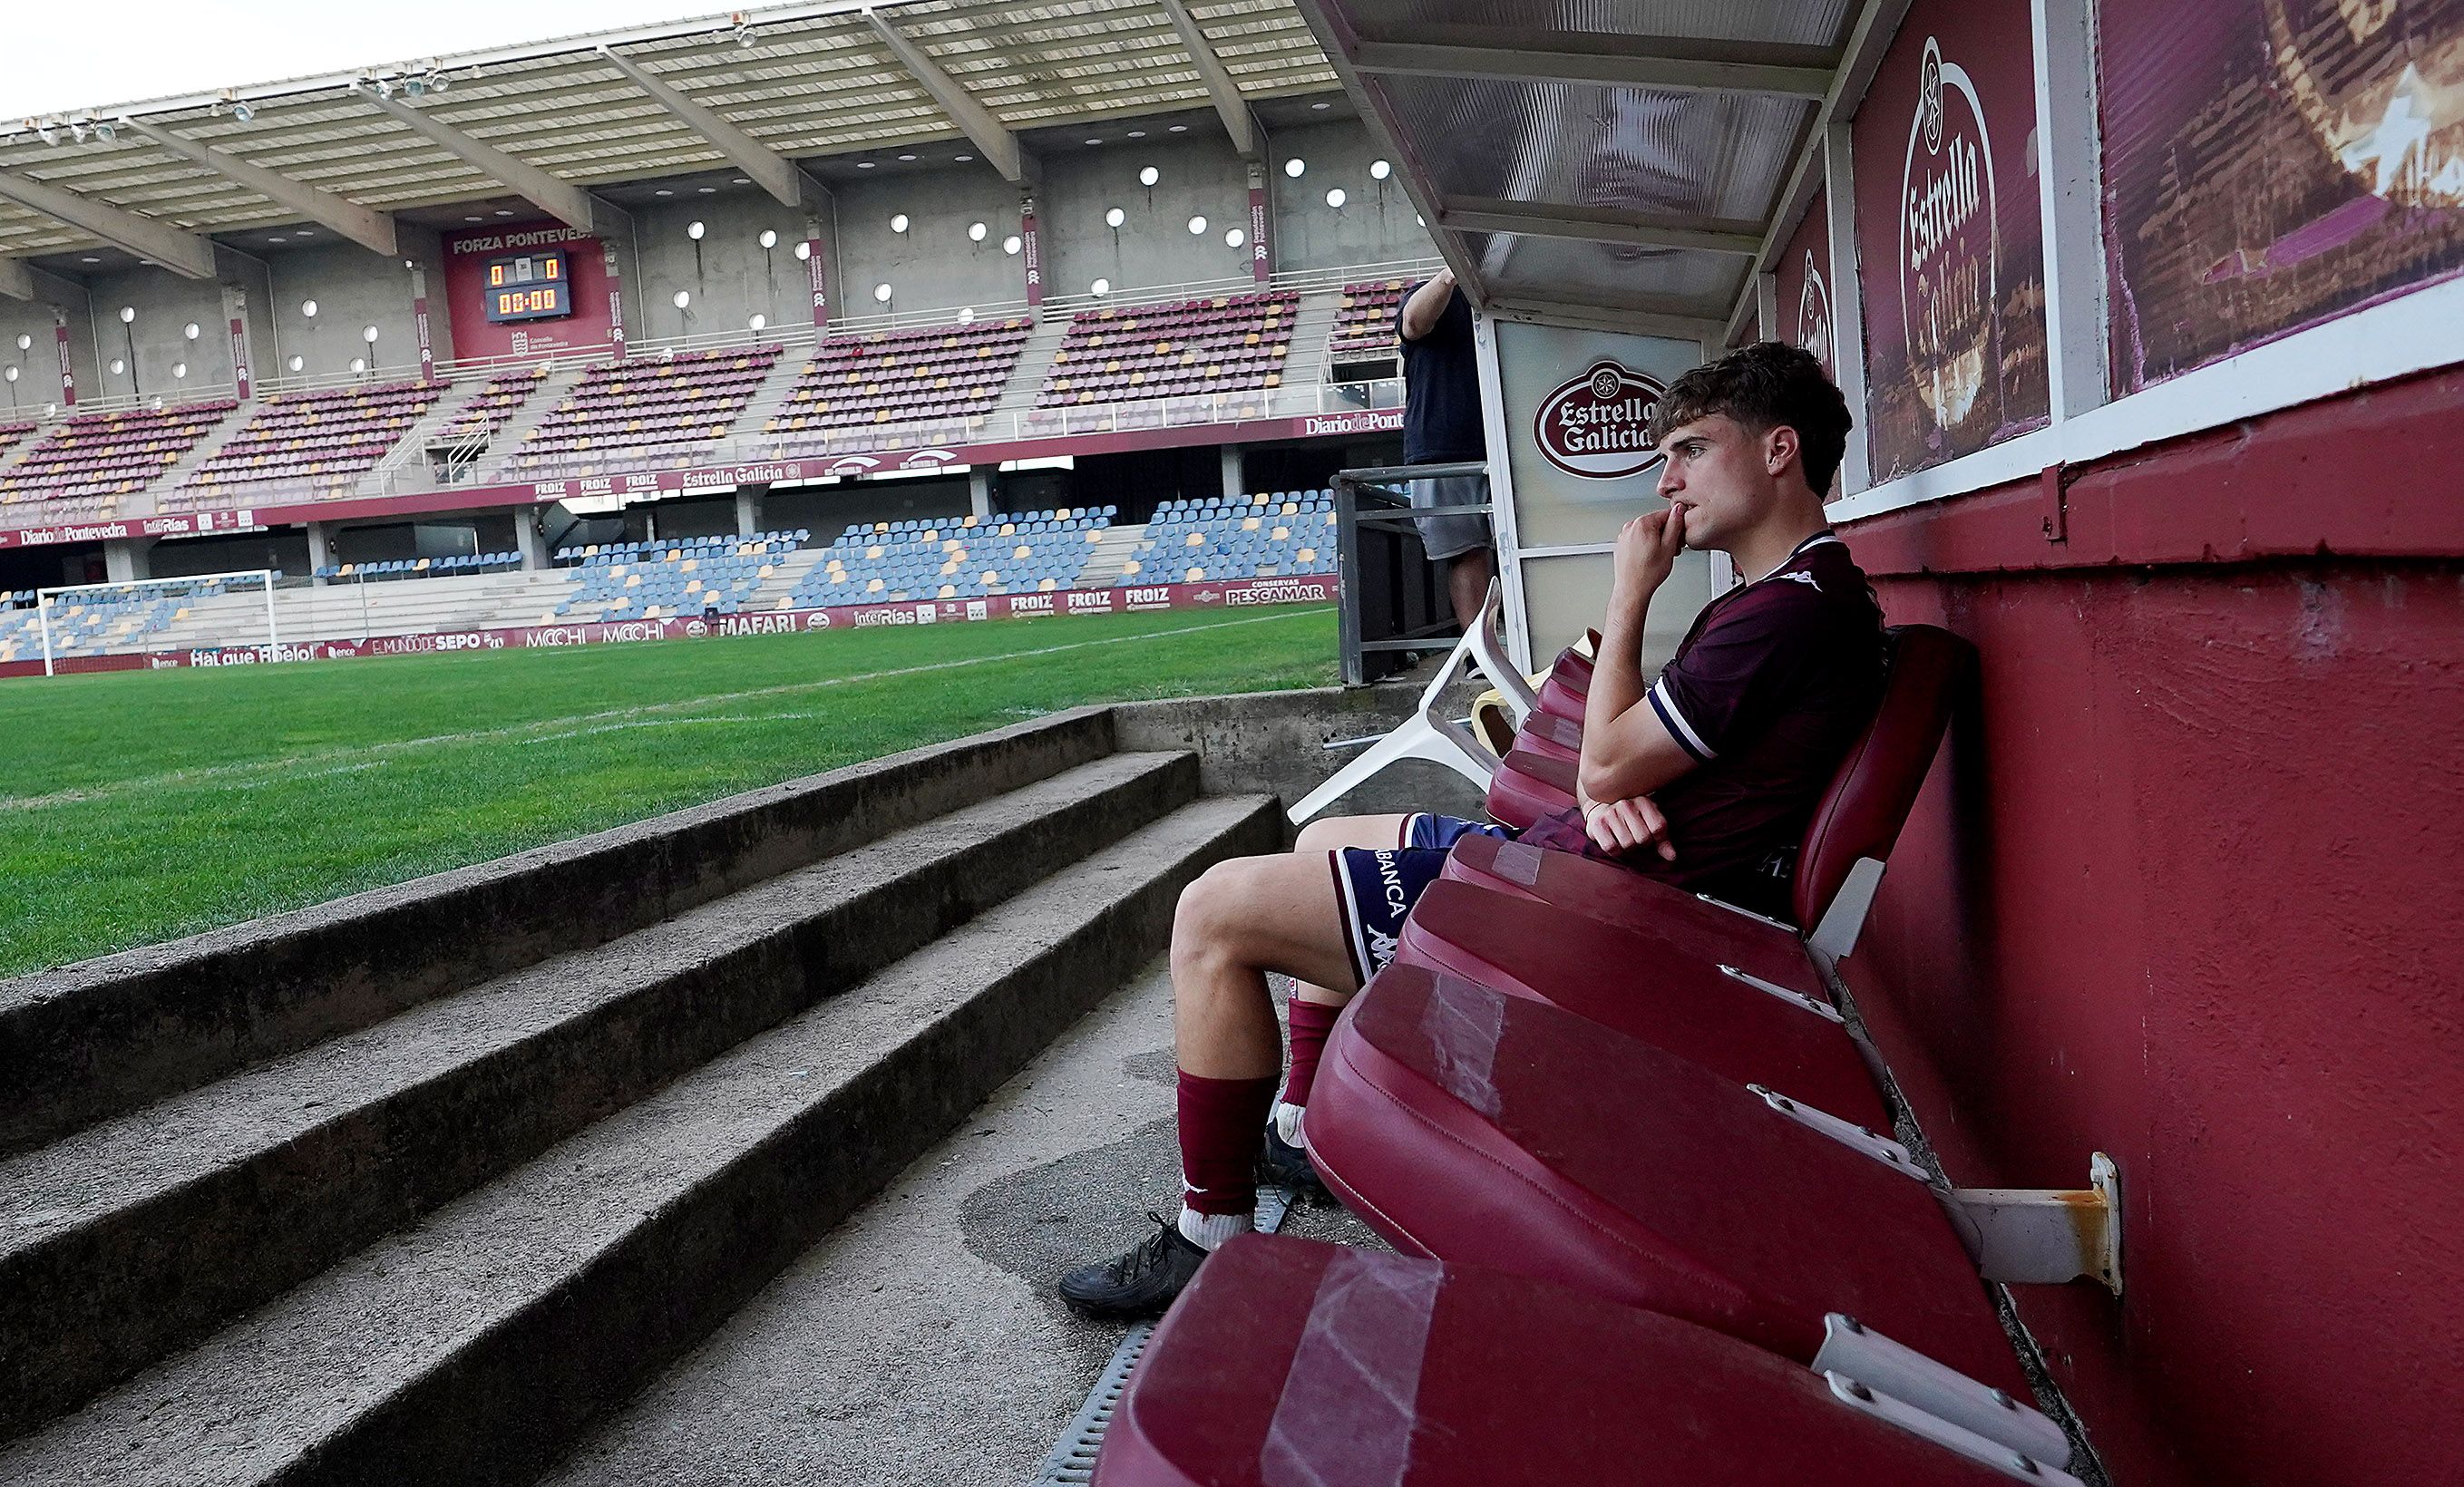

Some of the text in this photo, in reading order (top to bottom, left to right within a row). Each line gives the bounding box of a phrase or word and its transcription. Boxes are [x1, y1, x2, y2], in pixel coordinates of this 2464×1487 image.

[1909, 131, 1981, 272] Estrella
[453, 228, 592, 255] FORZA PONTEVE
[1558, 398, 1658, 426] Estrella
[1563, 423, 1653, 452] Galicia
[580, 478, 612, 491] FROIZ
[626, 474, 658, 487] FROIZ
[682, 464, 784, 488] Estrella Galicia
[535, 481, 567, 495] FROIZ
[1251, 578, 1300, 588] CONSERVAS
[1010, 594, 1054, 610] FROIZ
[1067, 591, 1112, 607] FROIZ
[1125, 588, 1170, 604] FROIZ
[1225, 584, 1327, 606] PESCAMAR
[435, 633, 481, 651] SEPO
